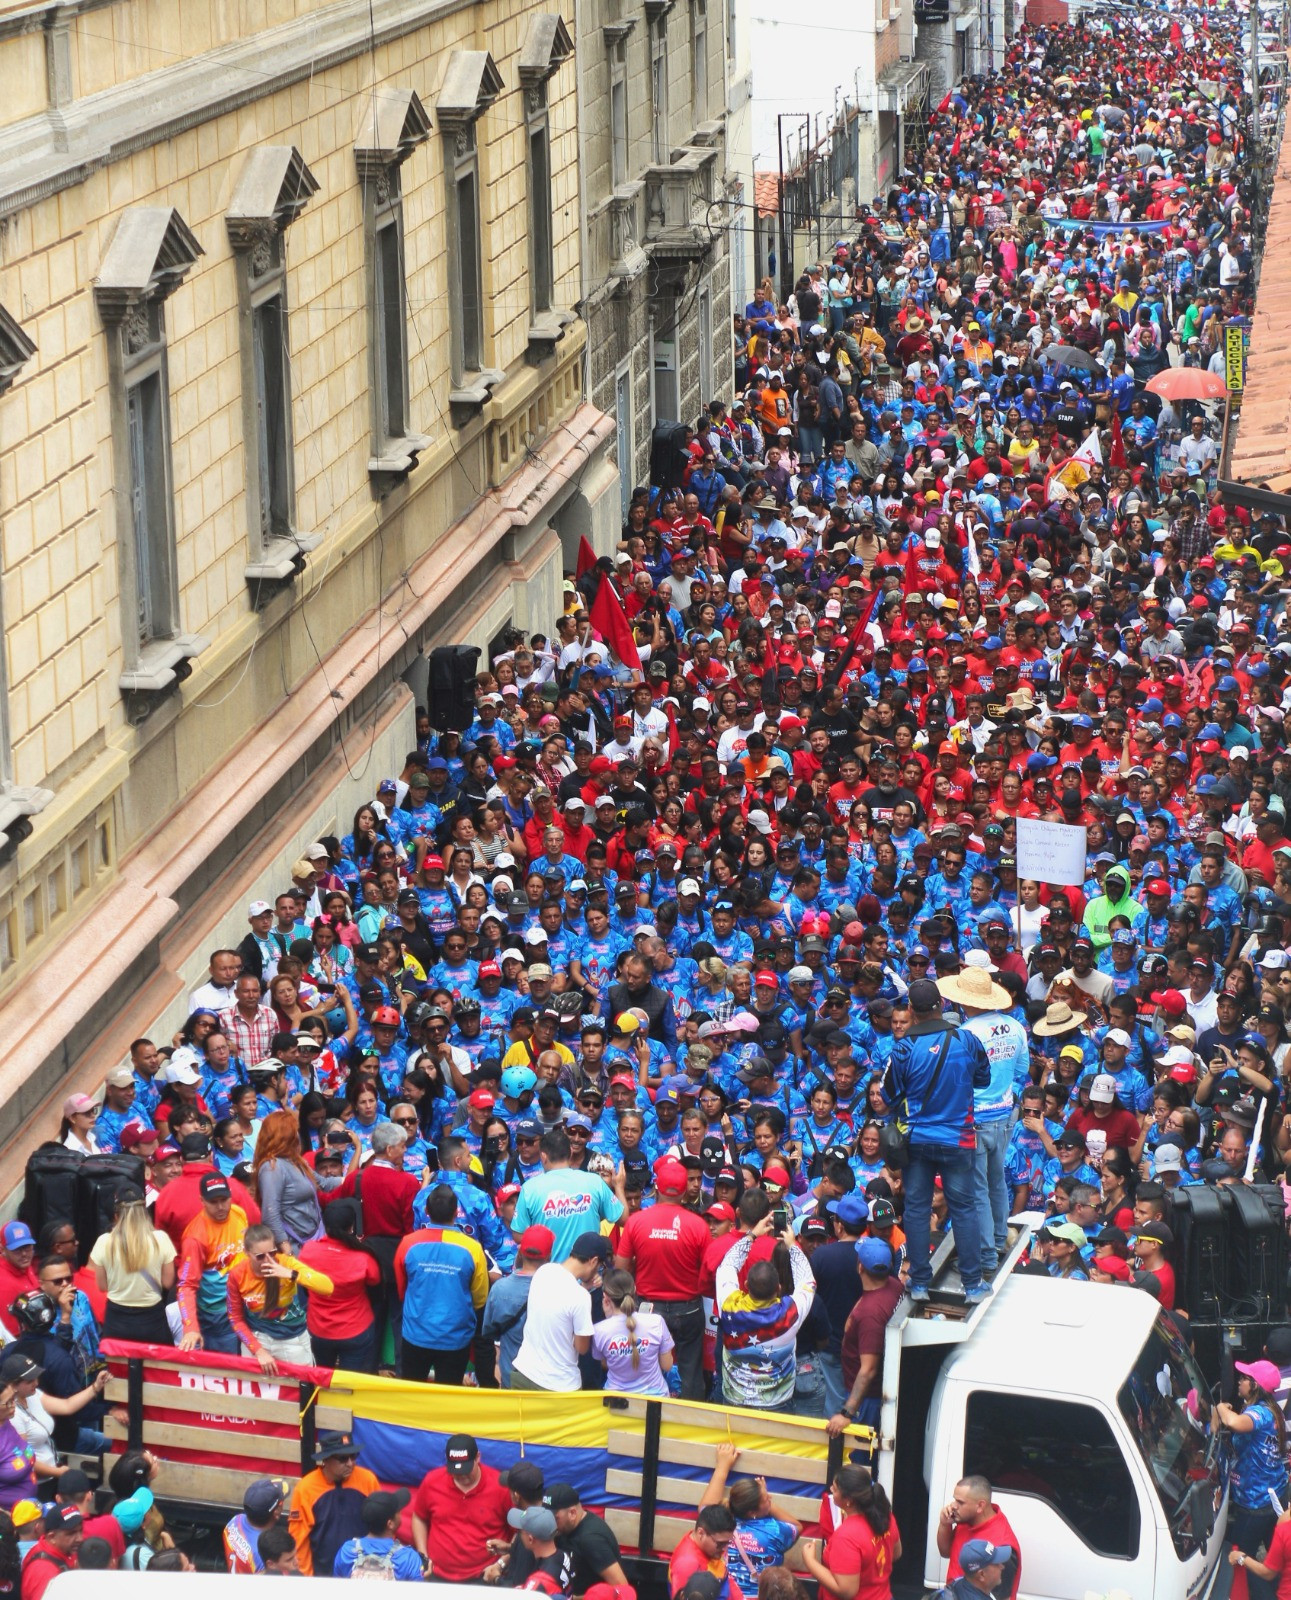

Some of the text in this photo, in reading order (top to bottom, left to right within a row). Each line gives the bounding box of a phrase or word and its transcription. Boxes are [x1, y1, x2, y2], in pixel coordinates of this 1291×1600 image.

[1229, 328, 1240, 389] FOTOCOPIAS
[990, 1024, 1011, 1038] X10
[994, 1045, 1017, 1055] BUEN
[449, 1449, 468, 1458] FURIA
